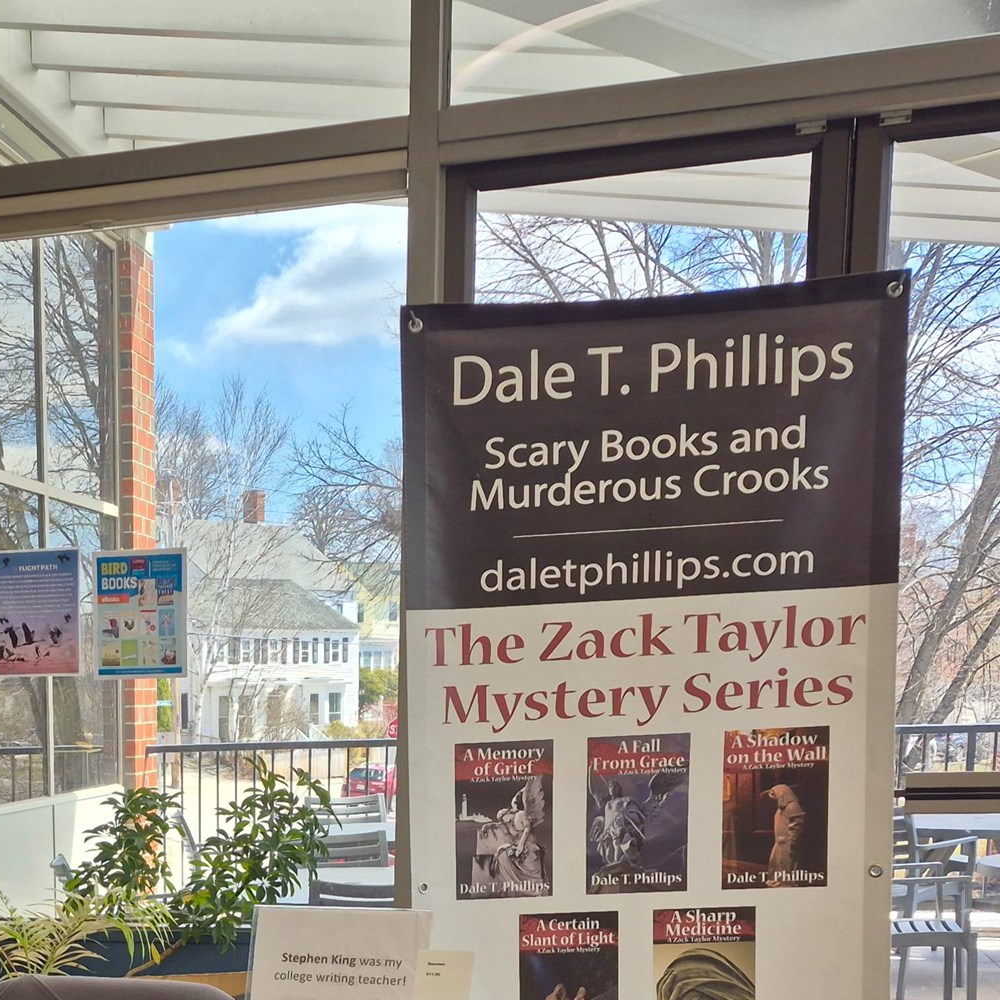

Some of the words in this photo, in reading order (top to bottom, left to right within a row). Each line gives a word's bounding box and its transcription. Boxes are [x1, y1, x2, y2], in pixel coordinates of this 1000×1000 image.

[453, 349, 575, 406] Dale
[588, 346, 631, 397] T.
[650, 333, 854, 397] Phillips
[484, 436, 589, 473] Scary
[601, 423, 718, 463] Books
[729, 415, 807, 454] and
[470, 473, 682, 513] Murderous
[693, 457, 830, 496] Crooks
[101, 562, 127, 575] BIRD
[480, 549, 814, 595] daletphillips.com
[101, 577, 137, 590] BOOKS
[424, 623, 525, 667] The
[539, 613, 674, 663] Zack
[684, 605, 867, 663] Taylor
[442, 681, 671, 733] Mystery
[682, 668, 854, 715] Series
[617, 740, 629, 755] A
[631, 738, 661, 754] Fall
[731, 734, 745, 748] A
[747, 731, 818, 748] Shadow
[462, 747, 474, 762] A
[476, 745, 545, 764] Memory
[536, 919, 547, 932] A
[548, 917, 600, 932] Certain
[670, 911, 684, 923] A
[687, 908, 737, 926] Sharp
[665, 920, 742, 937] Medicine
[281, 952, 328, 965] Stephen
[331, 954, 356, 968] King
[359, 957, 382, 967] was
[384, 959, 402, 969] my
[274, 971, 313, 983] college
[315, 972, 355, 985] writing
[358, 974, 406, 986] teacher!
